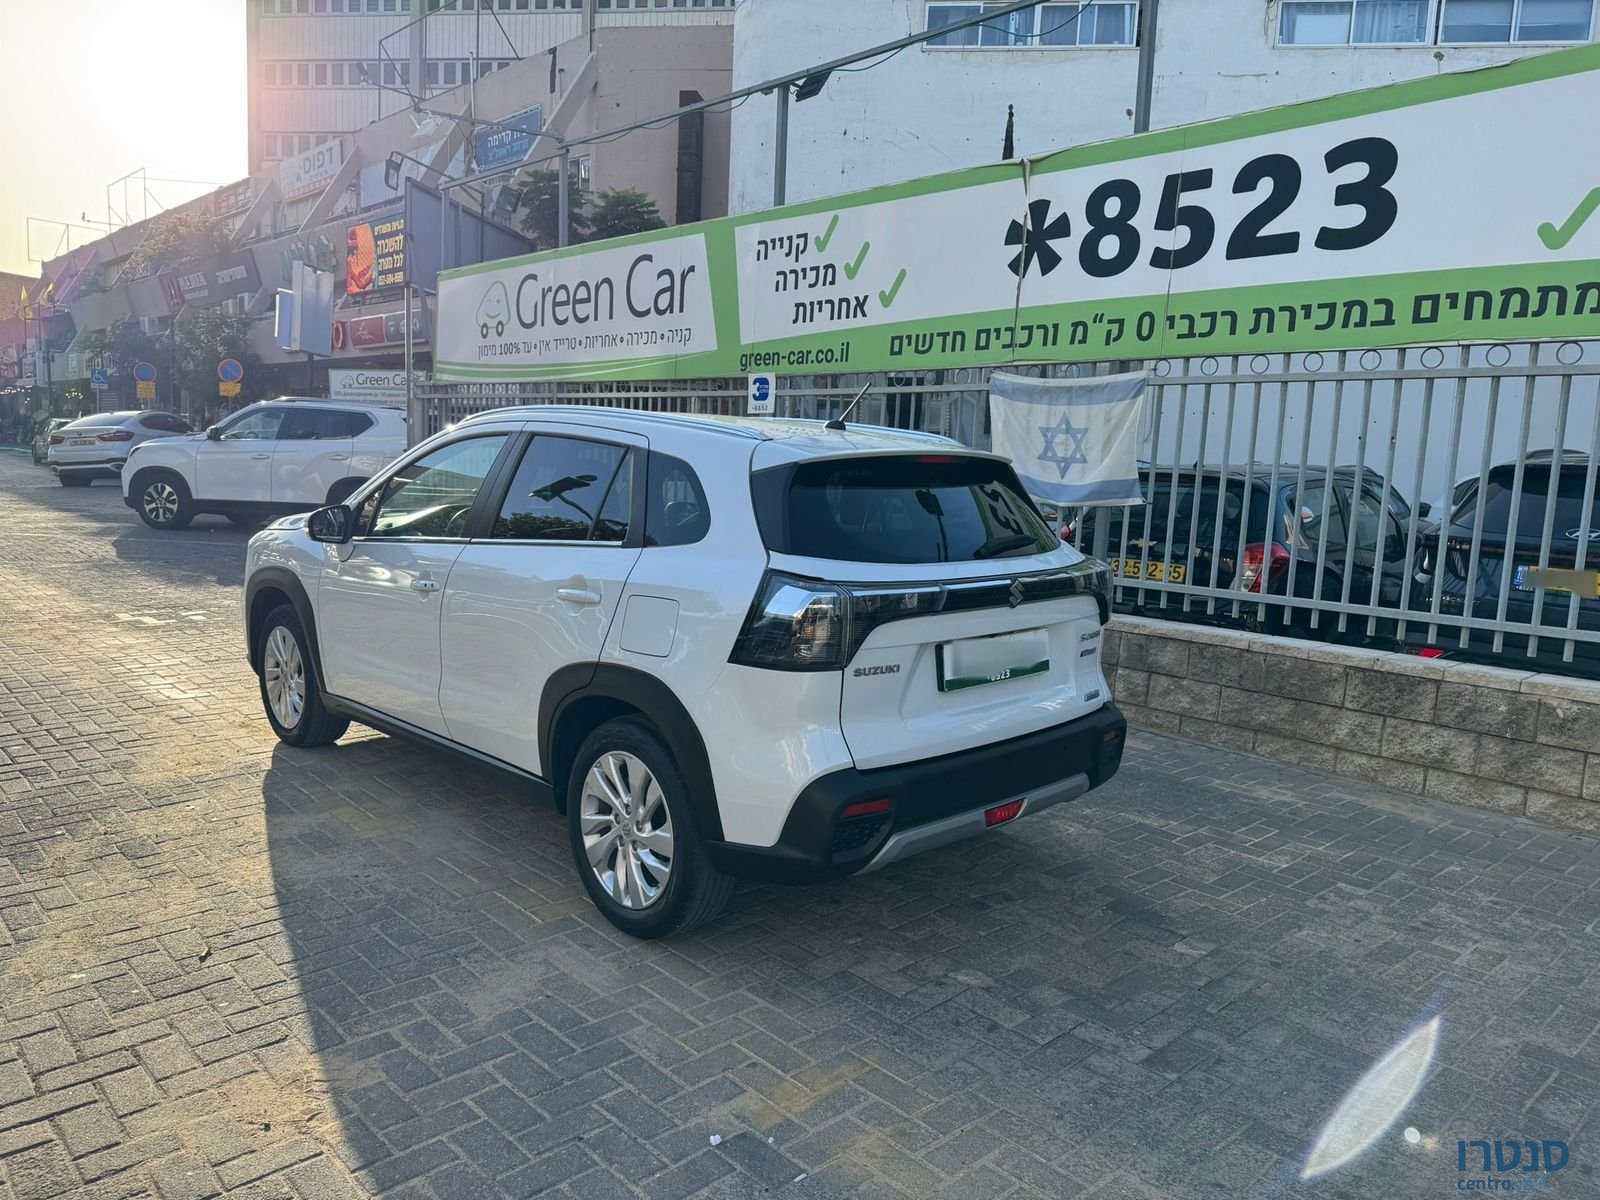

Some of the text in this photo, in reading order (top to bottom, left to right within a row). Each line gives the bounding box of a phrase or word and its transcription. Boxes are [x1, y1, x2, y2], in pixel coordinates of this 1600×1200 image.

[487, 130, 512, 149] קדימה
[303, 146, 334, 175] דפוס
[756, 232, 809, 263] קנייה
[516, 253, 696, 330] Green Car
[775, 263, 837, 292] מכירה
[792, 294, 869, 324] אחריות
[1248, 297, 1396, 335] במכירת
[1411, 282, 1600, 325] מתמחים
[974, 322, 1060, 352] ורכבים
[1136, 310, 1156, 342] 0
[1165, 310, 1238, 340] רכבי
[478, 327, 692, 360] קניה מכירה אחריות טרייד אין עד 100% מימון
[739, 341, 850, 372] green-car.co.il
[889, 330, 966, 357] חדשים
[356, 373, 407, 386] Green Ca
[853, 663, 900, 677] SUZUKI
